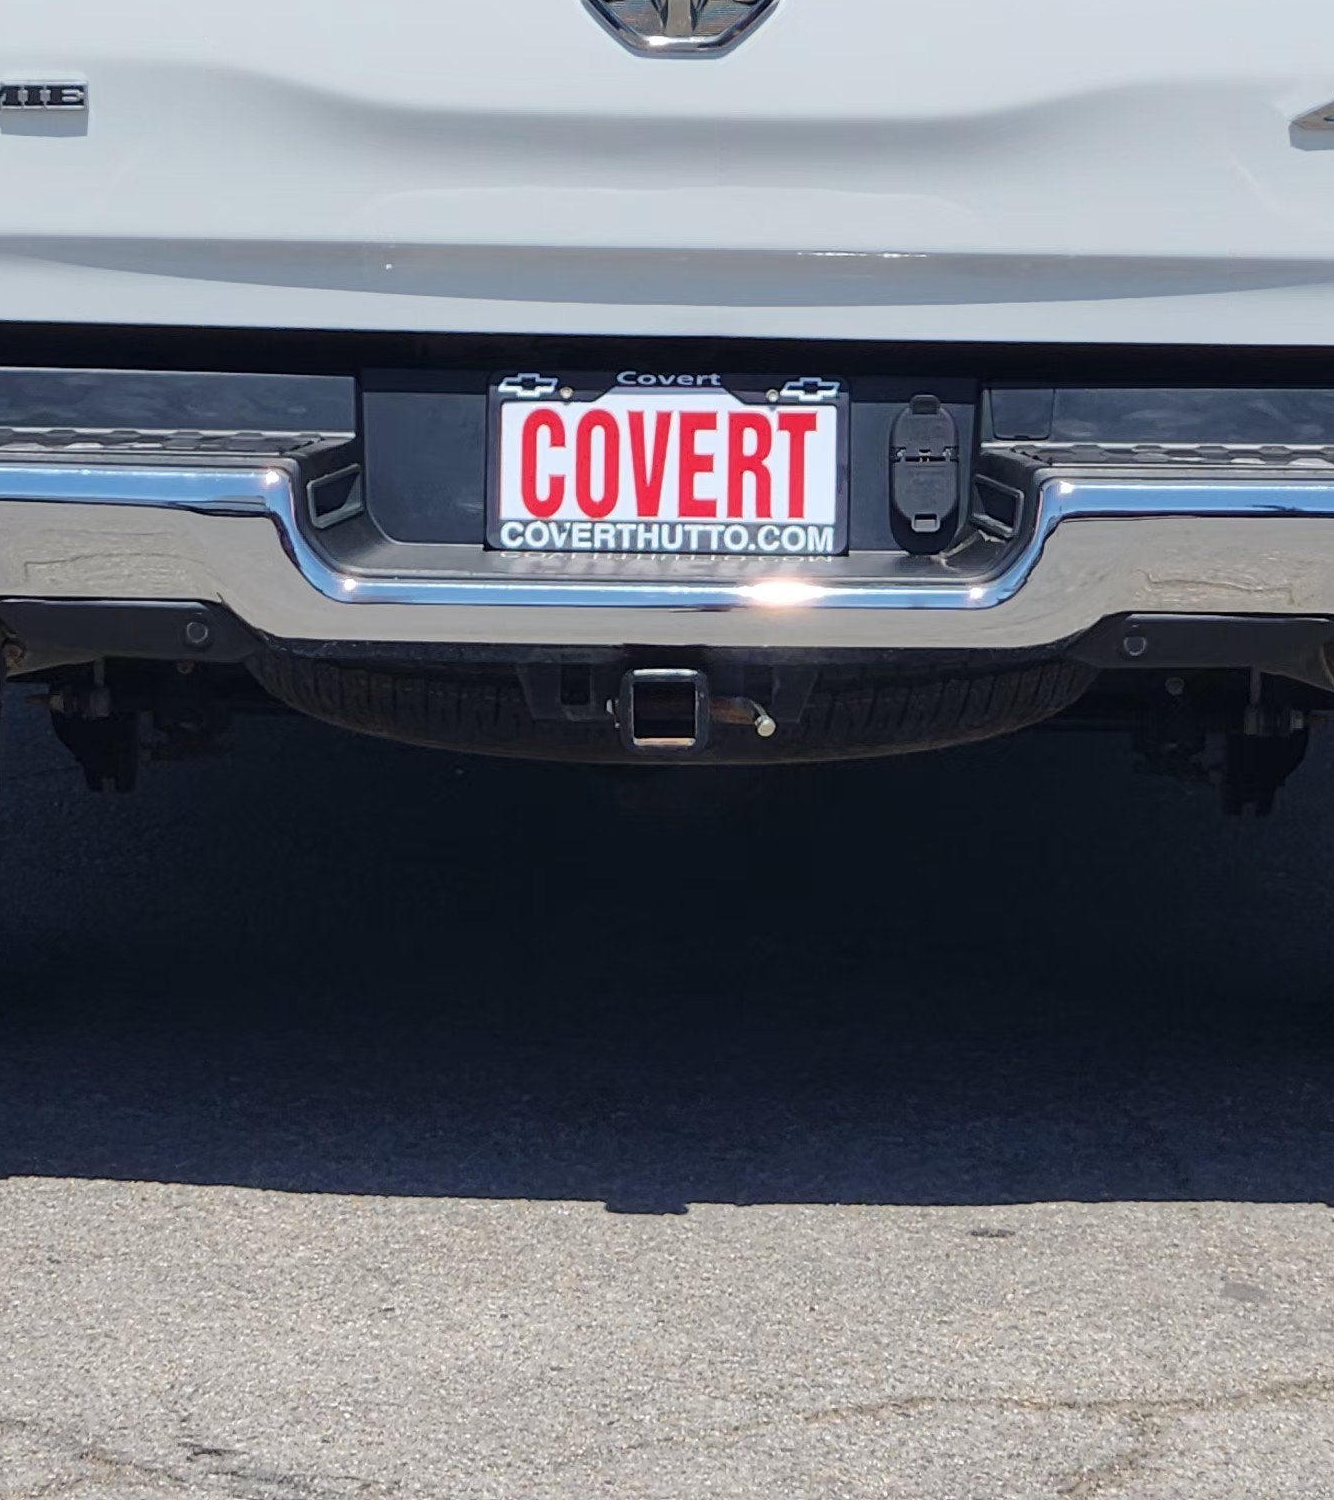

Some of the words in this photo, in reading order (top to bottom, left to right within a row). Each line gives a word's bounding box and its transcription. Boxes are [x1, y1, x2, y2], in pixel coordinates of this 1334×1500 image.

[616, 371, 722, 387] Covert
[521, 408, 818, 519] COVERT
[499, 521, 835, 552] COVERTHUTTO.COM
